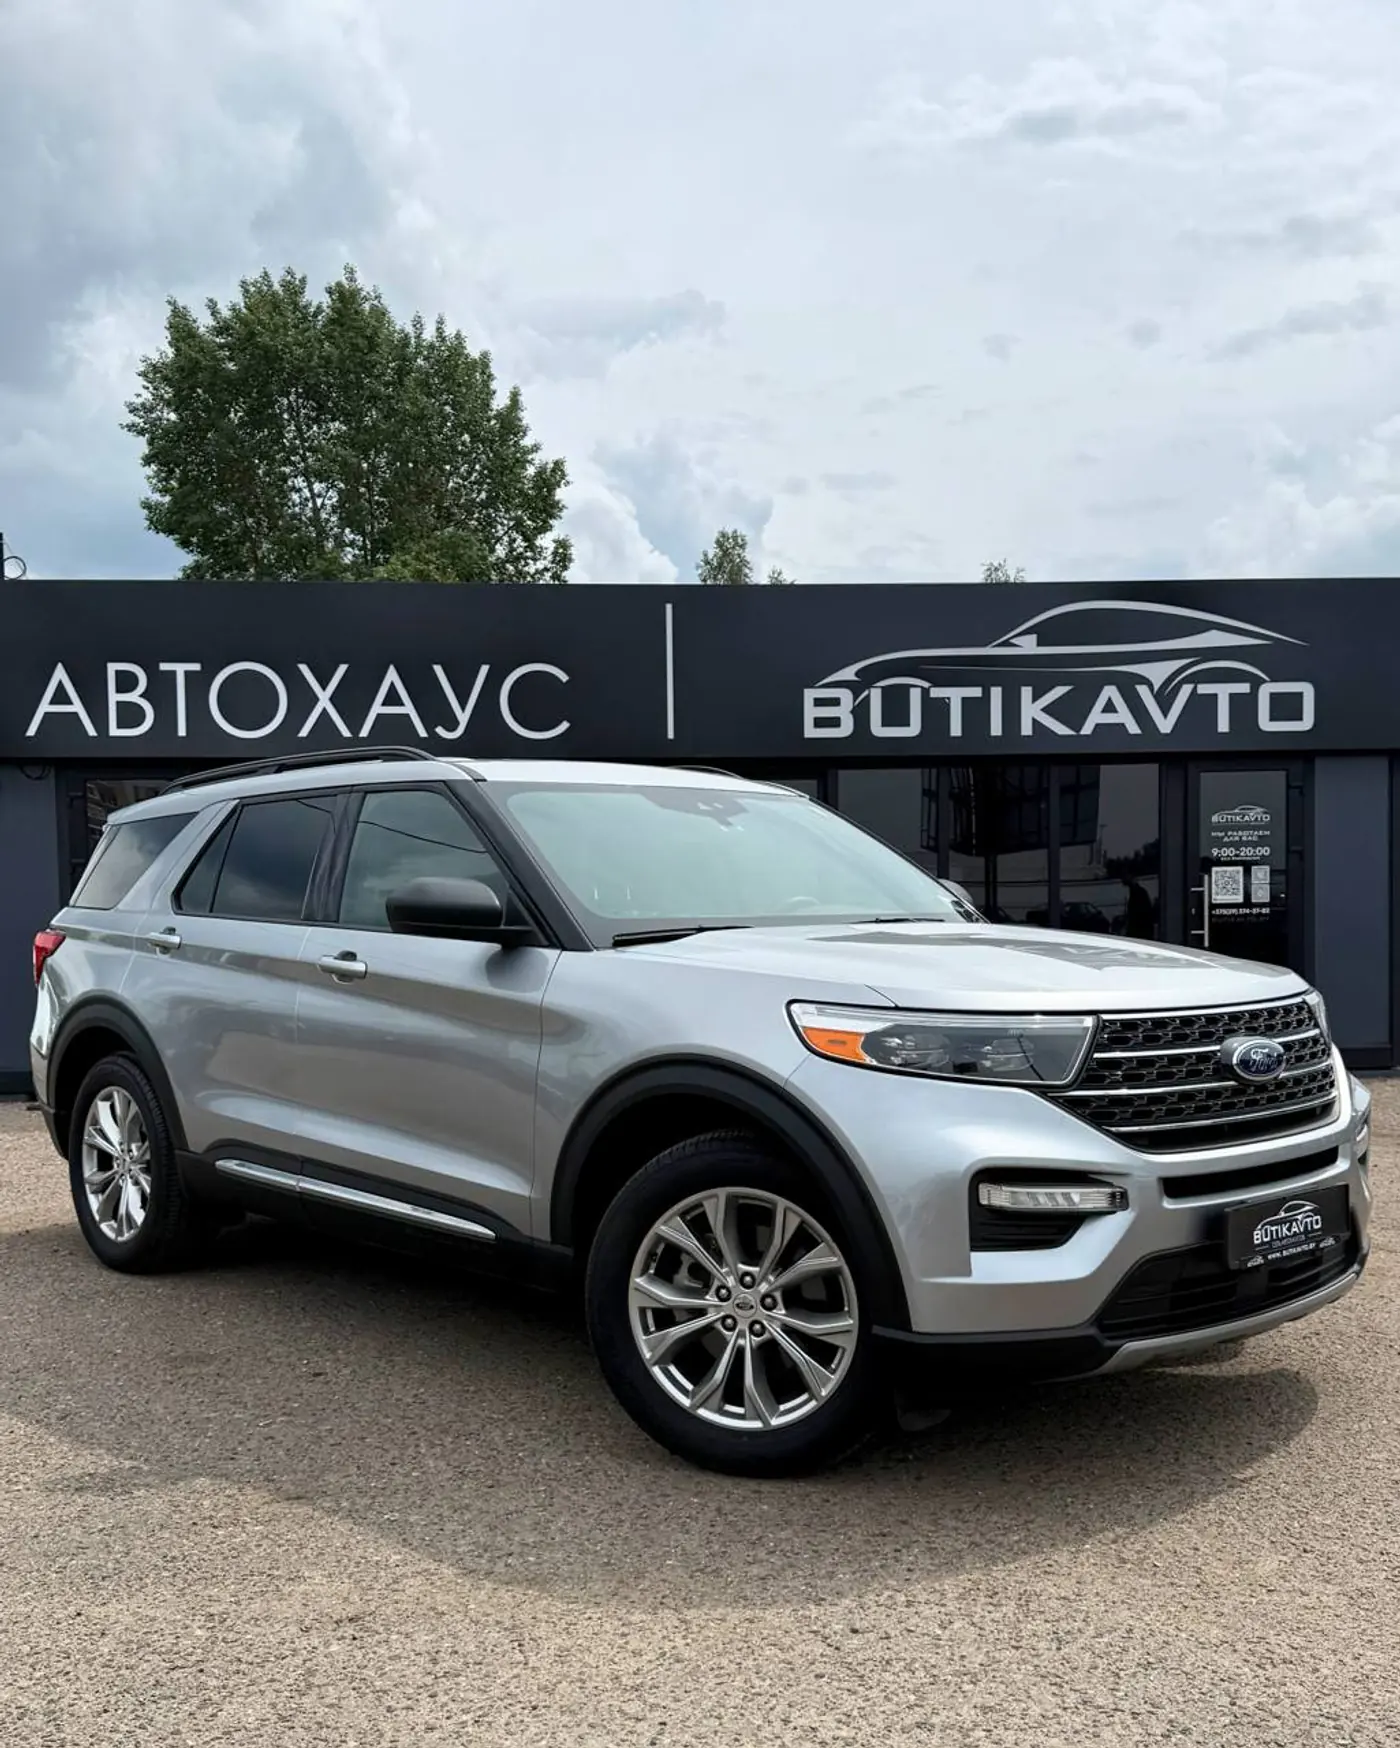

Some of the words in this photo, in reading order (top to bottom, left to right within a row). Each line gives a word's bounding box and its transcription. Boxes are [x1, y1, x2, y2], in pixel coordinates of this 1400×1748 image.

[25, 661, 571, 740] АВТОХАУС
[803, 681, 1315, 739] BUTIKAVTO
[1211, 814, 1270, 822] BUTIKAVTO
[1211, 847, 1270, 857] 9:00-20:00
[1253, 1215, 1322, 1244] BUTIKAVTO
